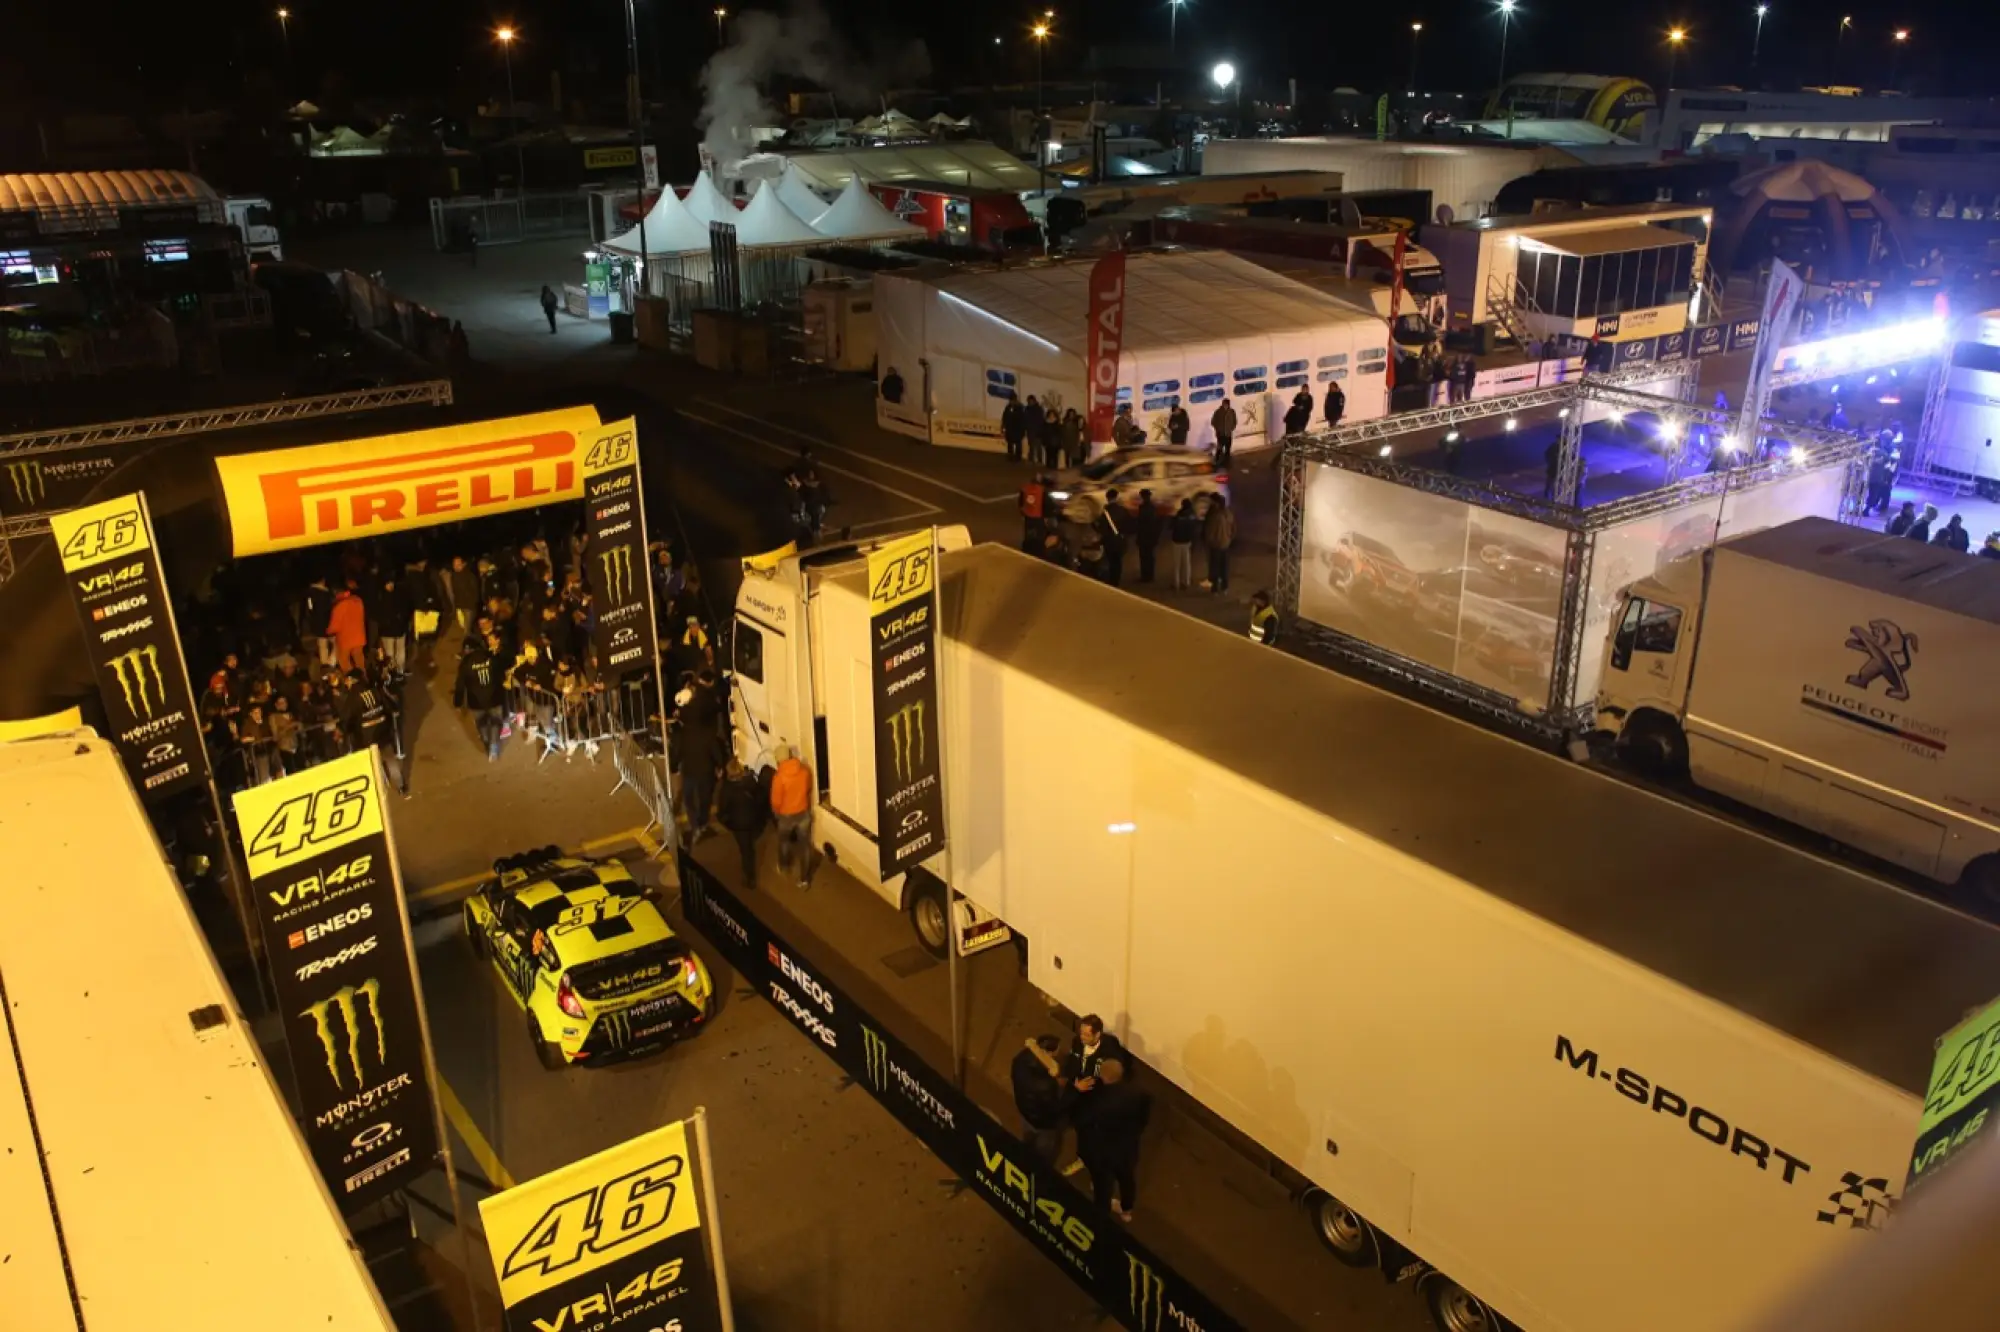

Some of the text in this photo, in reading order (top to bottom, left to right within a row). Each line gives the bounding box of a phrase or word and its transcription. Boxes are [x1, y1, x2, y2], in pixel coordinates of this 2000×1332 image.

[1090, 276, 1122, 413] TOTAL
[583, 430, 632, 469] 46
[259, 430, 577, 542] PIRELLI
[63, 509, 138, 561] 46
[872, 546, 930, 604] 46
[104, 594, 149, 618] ENEOS
[893, 642, 926, 668] ENEOS
[121, 710, 186, 742] MONSTER
[1802, 683, 1900, 724] PEUGEOT
[248, 774, 370, 859] 46
[273, 877, 376, 923] RACING APPAREL
[304, 902, 373, 943] ENEOS
[779, 951, 835, 1015] ENEOS
[315, 1072, 413, 1129] MONSTER
[890, 1059, 956, 1130] MONSTER
[1554, 1033, 1812, 1186] M-SPORT
[342, 1127, 404, 1164] OAKLEY
[344, 1146, 411, 1194] PIRELLI
[501, 1153, 684, 1282] 46
[976, 1168, 1094, 1281] RACING APPAREL
[611, 1286, 689, 1325] APPAREL
